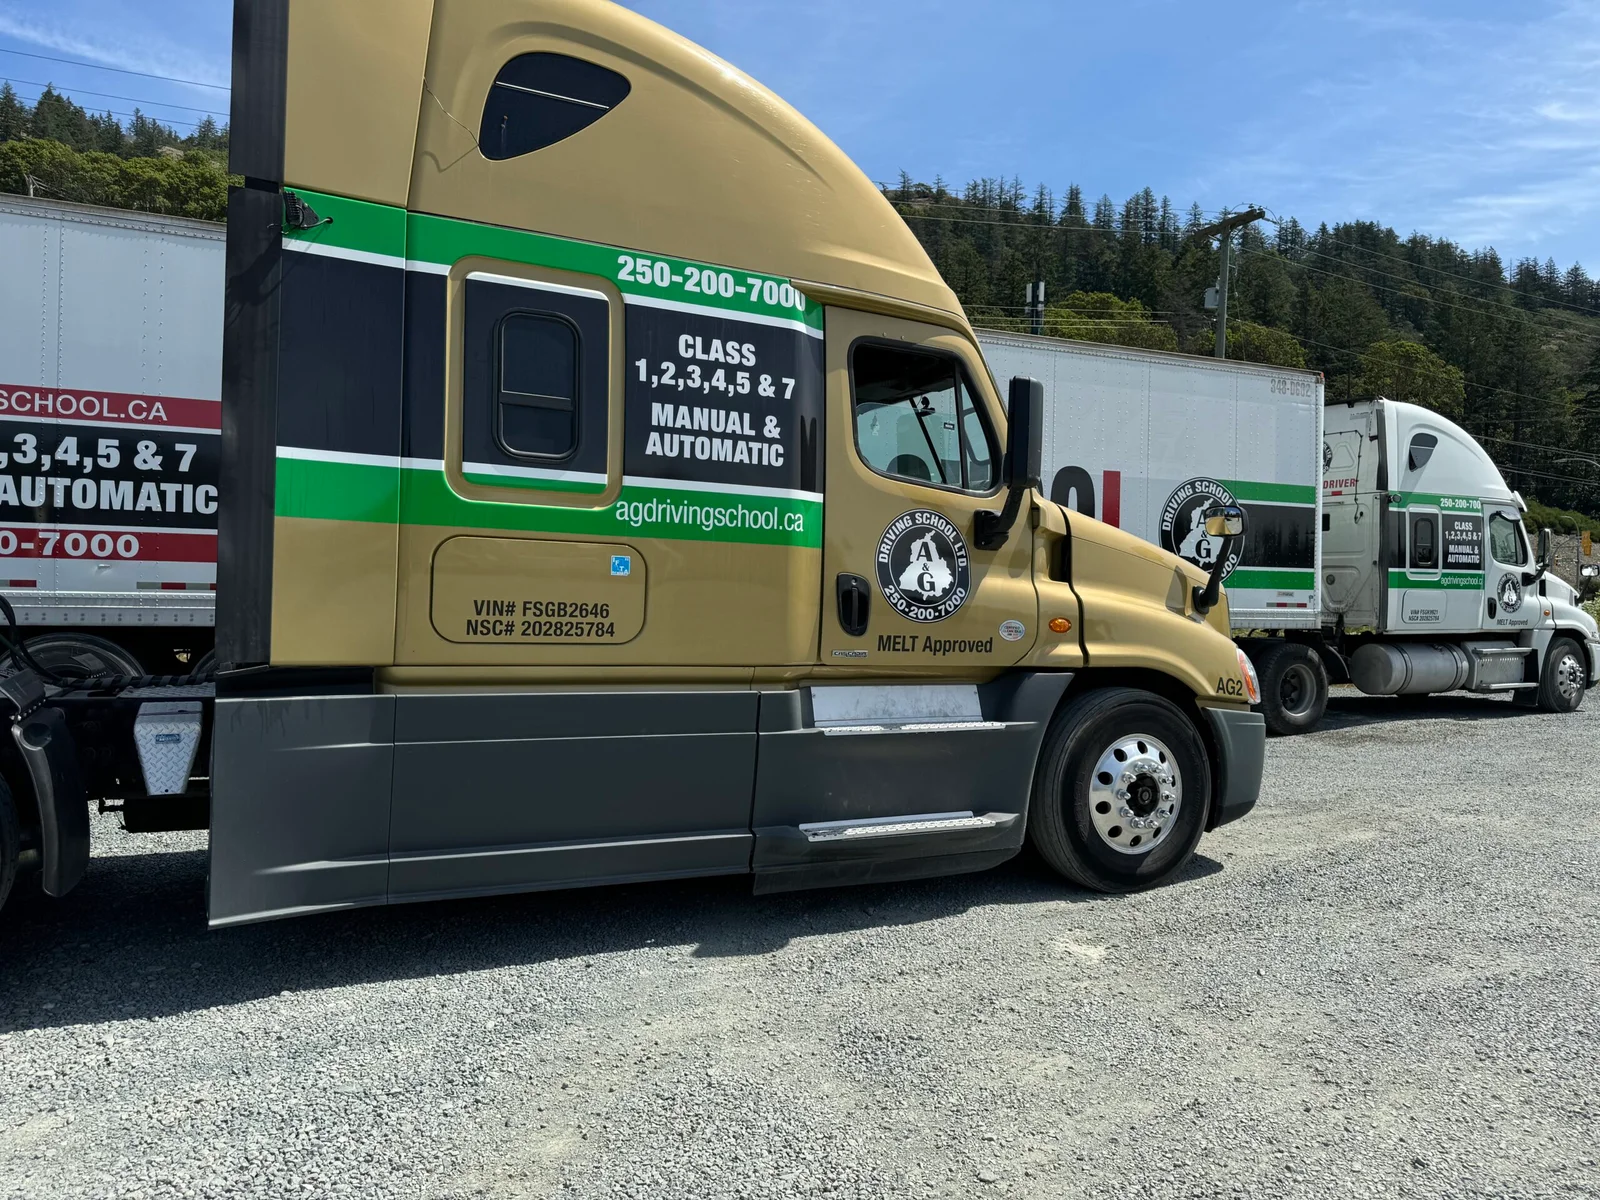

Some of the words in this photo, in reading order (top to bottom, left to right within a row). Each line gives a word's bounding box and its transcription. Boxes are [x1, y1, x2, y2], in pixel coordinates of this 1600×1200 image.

[617, 255, 806, 311] 250-200-7000
[678, 334, 756, 366] CLASS
[635, 358, 751, 396] 1,2,3,4,5
[758, 374, 776, 397] &
[782, 377, 796, 399] 7
[651, 402, 756, 436] MANUAL
[763, 415, 781, 439] &
[133, 440, 163, 471] &
[175, 443, 197, 472] 7
[645, 431, 784, 467] AUTOMATIC
[0, 474, 219, 514] AUTOMATIC
[1323, 478, 1356, 489] DRIVER
[615, 499, 804, 533] agdrivingschool.ca
[1162, 484, 1194, 531] DRIVING
[1454, 521, 1473, 531] CLASS
[878, 515, 913, 563] DRIVING
[915, 512, 957, 542] SCHOOL
[953, 541, 967, 572] LTD.
[916, 541, 933, 562] A
[1195, 539, 1212, 559] G
[922, 562, 930, 571] &
[1447, 554, 1480, 564] AUTOMATIC
[917, 572, 936, 592] G
[473, 600, 516, 617] VIN#
[522, 601, 610, 619] FSGB2646
[884, 585, 966, 620] 250-200-7000
[465, 619, 515, 637] NSC#
[520, 621, 615, 638] 202825784
[1508, 619, 1528, 627] Approved
[877, 635, 919, 652] MELT
[922, 636, 993, 656] Approved
[1216, 677, 1243, 696] AG2
